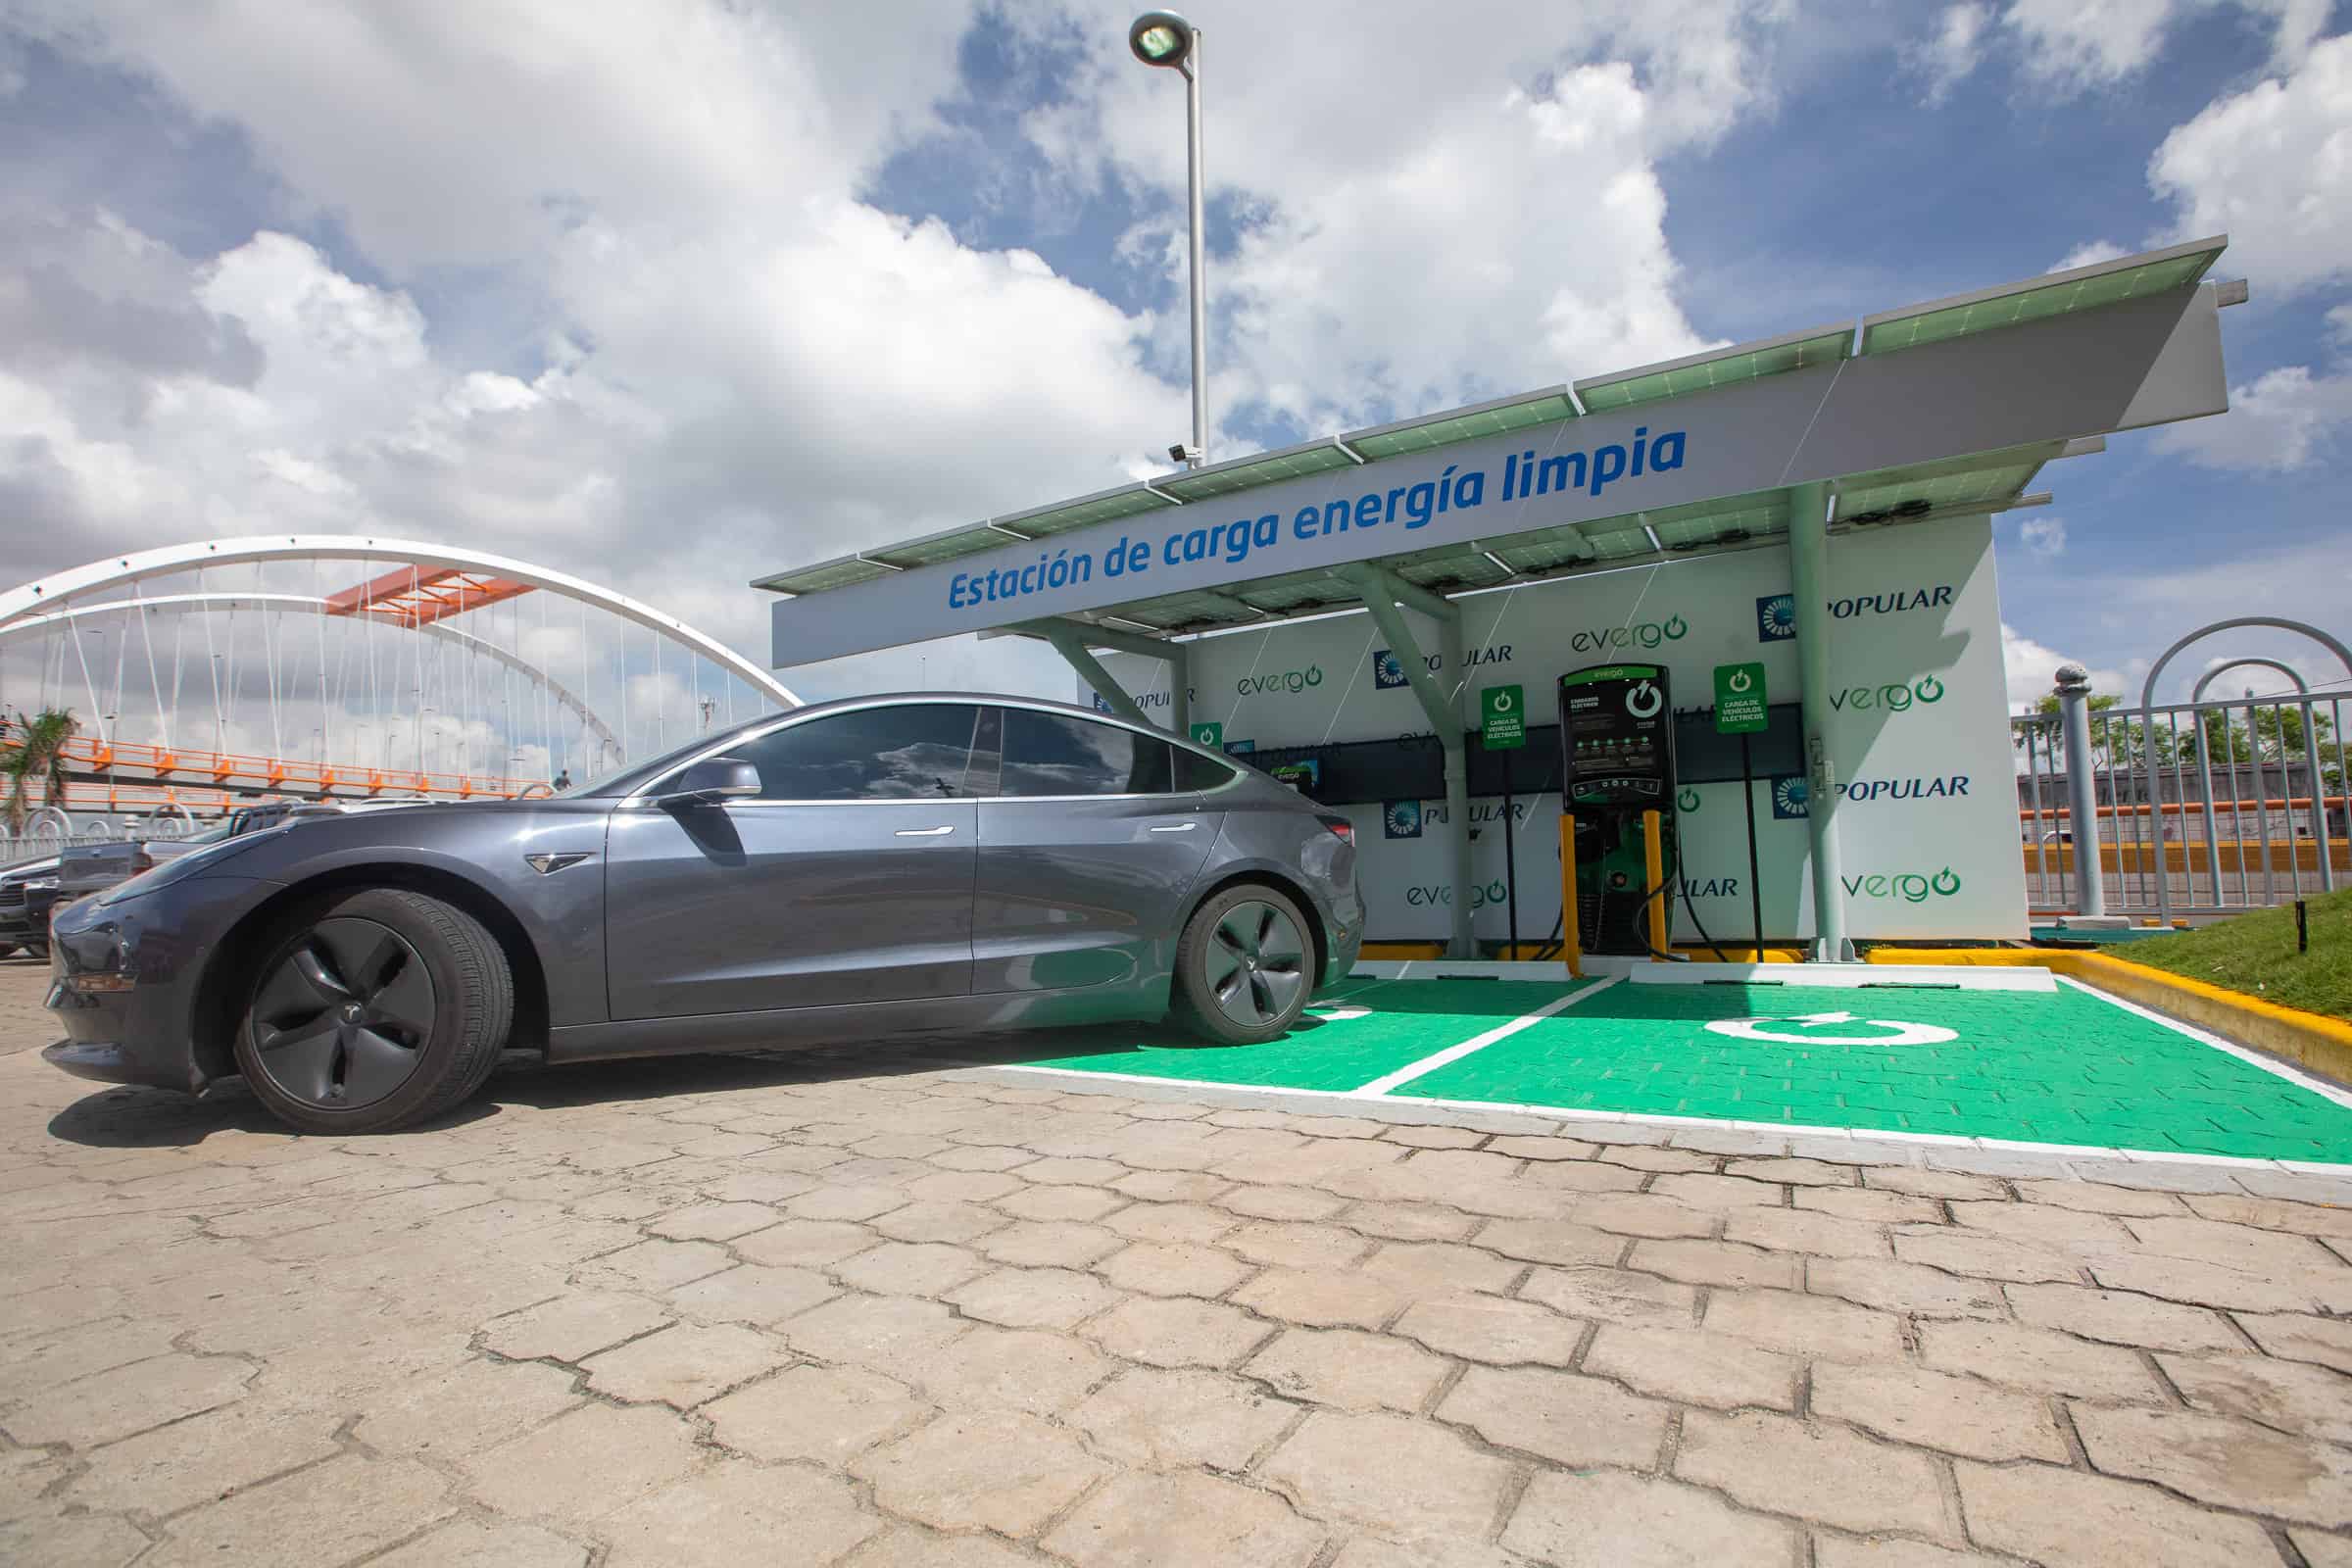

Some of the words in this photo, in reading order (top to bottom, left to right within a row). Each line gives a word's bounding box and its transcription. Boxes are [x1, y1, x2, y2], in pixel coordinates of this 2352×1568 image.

[949, 549, 1092, 610] Estación
[1104, 537, 1151, 577] de
[1163, 514, 1279, 564] carga
[1293, 465, 1485, 540] energía
[1502, 426, 1687, 502] limpia
[1827, 585, 1952, 619] OPULAR
[1571, 613, 1688, 653] evergo
[1238, 663, 1322, 696] evergo
[1829, 673, 1944, 712] vergo
[1840, 865, 1961, 903] vergo
